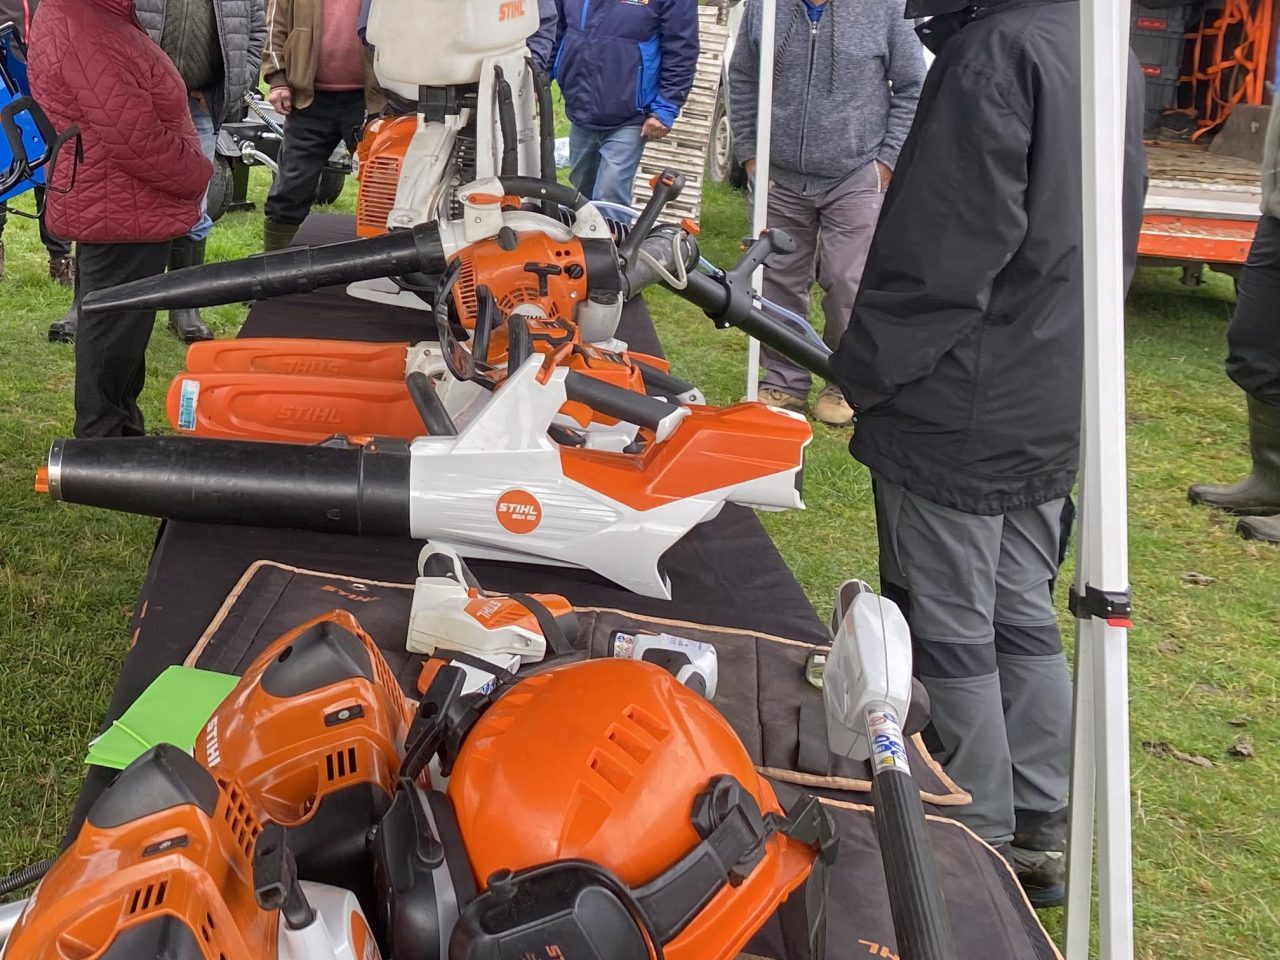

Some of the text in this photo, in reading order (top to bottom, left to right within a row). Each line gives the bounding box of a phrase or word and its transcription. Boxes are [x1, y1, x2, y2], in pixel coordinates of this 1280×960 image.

[498, 0, 525, 22] STIHL
[276, 406, 343, 426] STIHL
[498, 502, 538, 515] STIHL
[475, 600, 503, 619] STIHL
